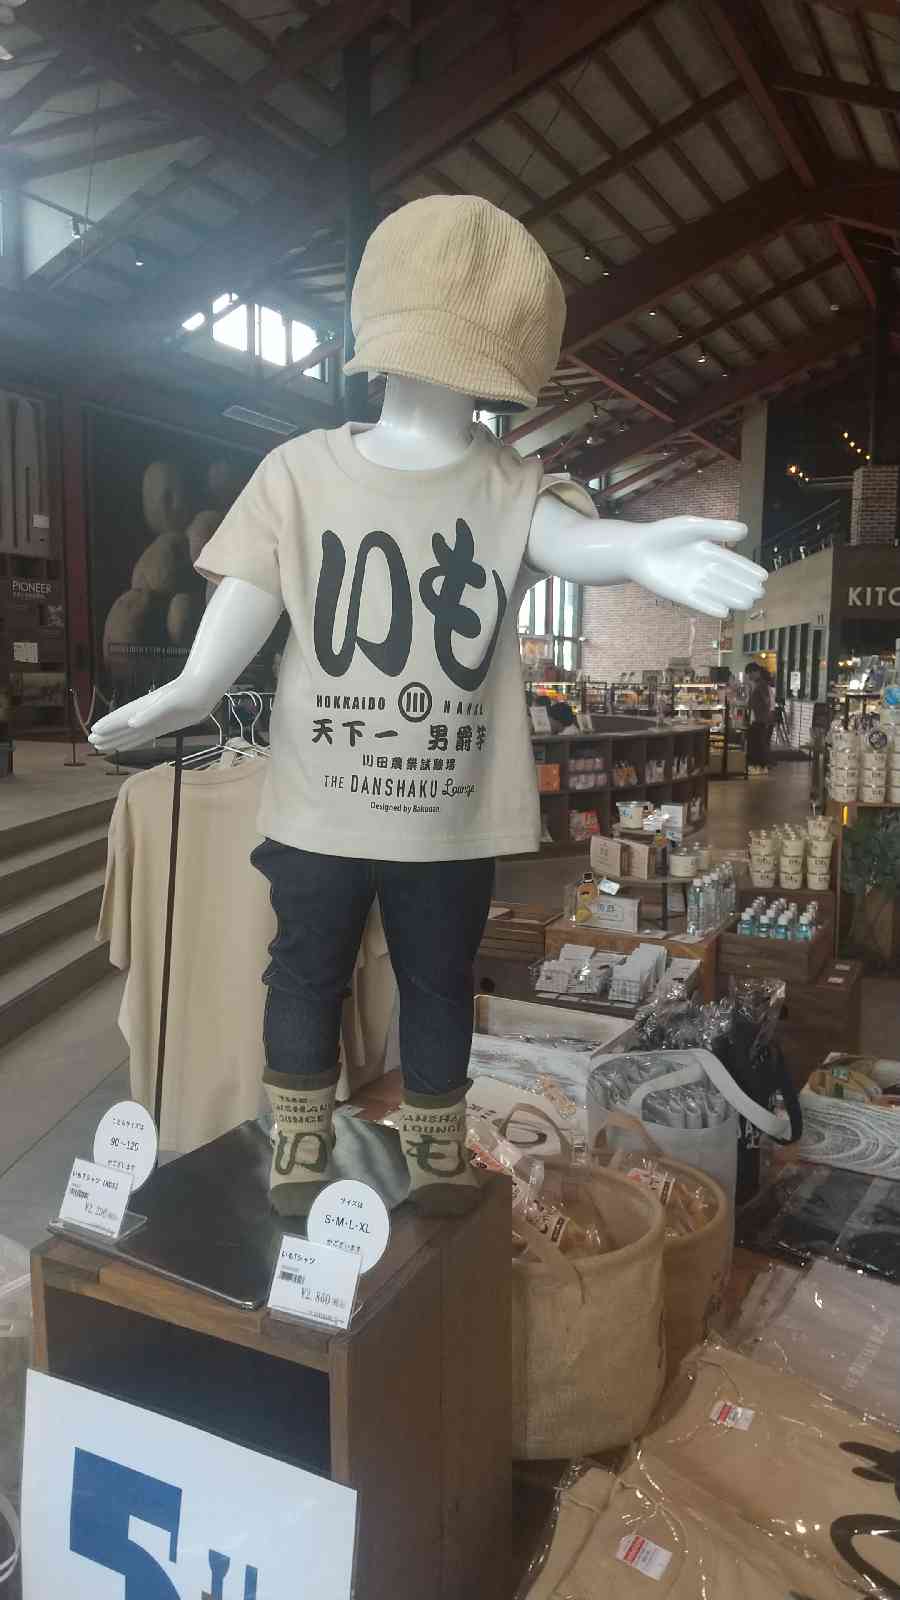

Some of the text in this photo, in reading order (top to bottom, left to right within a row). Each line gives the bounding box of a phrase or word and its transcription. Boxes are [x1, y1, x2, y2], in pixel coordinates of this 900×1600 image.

[11, 581, 52, 594] PIONEER
[848, 587, 900, 606] KITC
[316, 694, 386, 710] HOKKAIDO
[312, 718, 399, 747] 天下一
[324, 775, 475, 798] THE DANSHAKU Lounge
[371, 802, 401, 812] Designed
[403, 804, 412, 814] by
